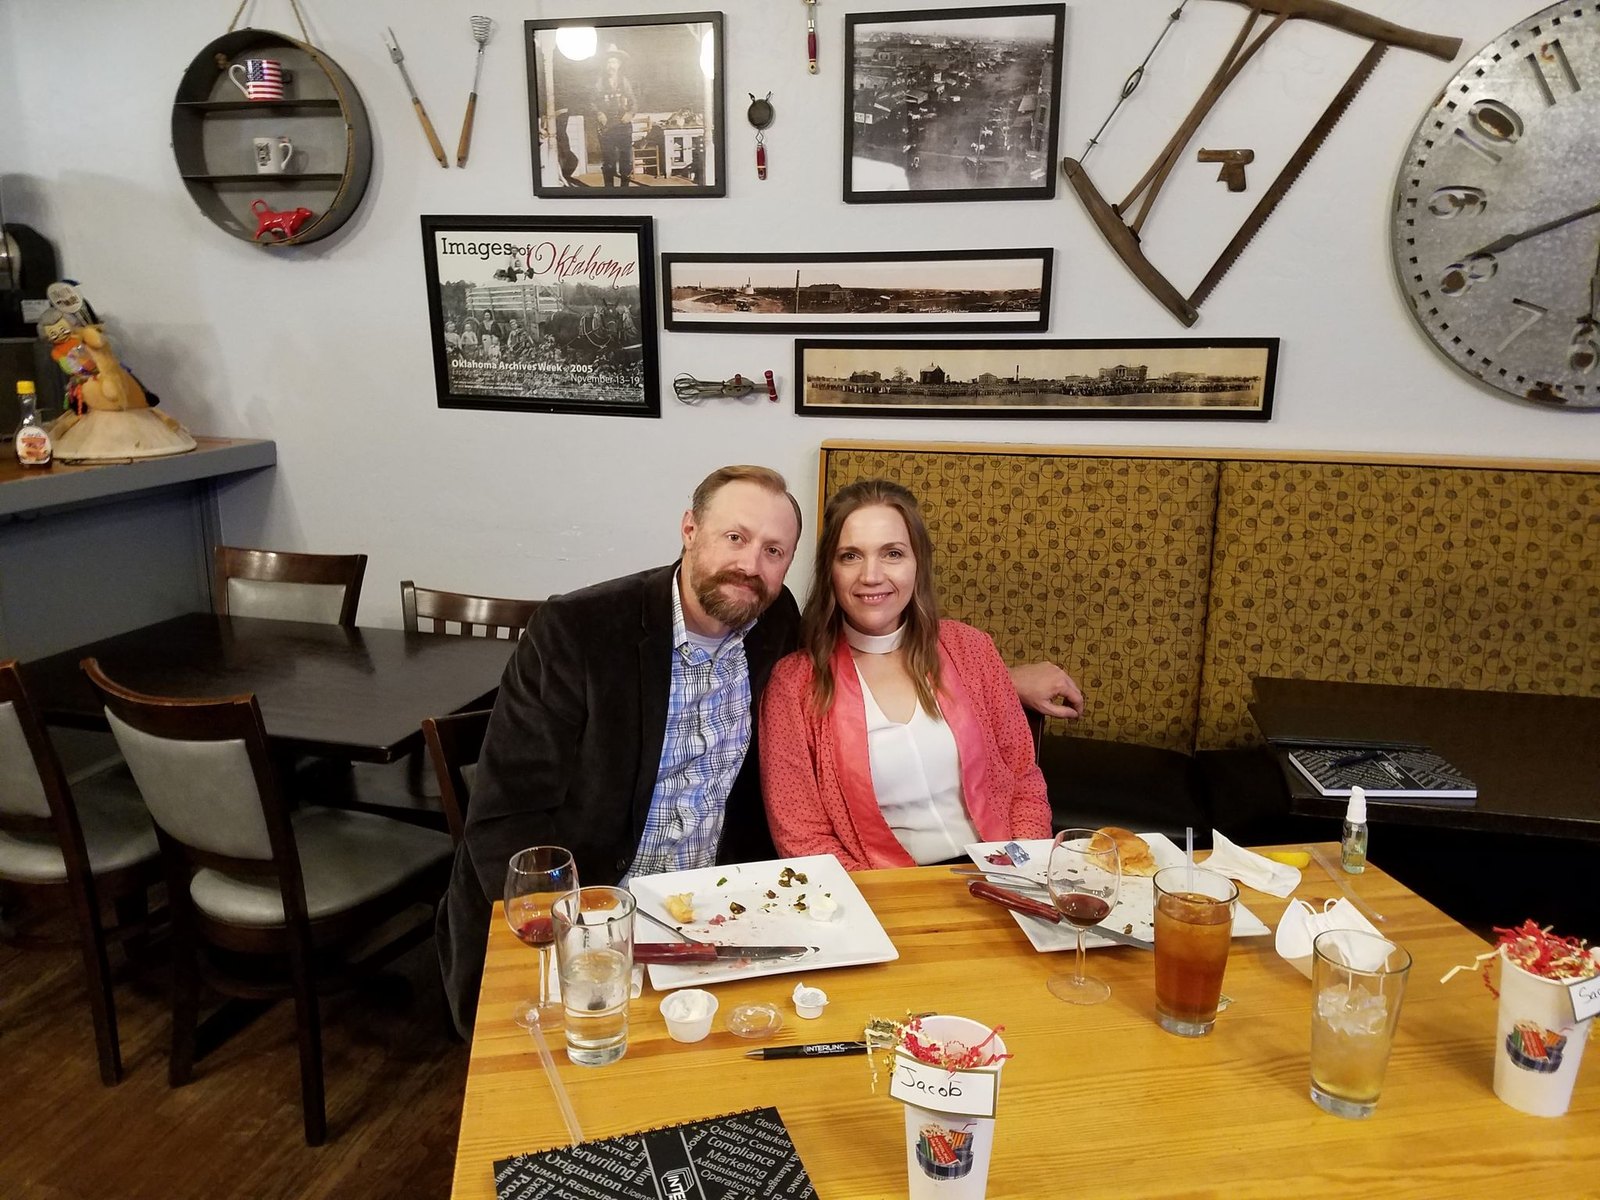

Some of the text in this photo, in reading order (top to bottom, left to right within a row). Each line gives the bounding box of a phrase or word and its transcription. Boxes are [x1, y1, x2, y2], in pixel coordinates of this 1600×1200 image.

[441, 237, 513, 260] Images
[526, 241, 636, 290] Oklahoma
[451, 359, 498, 369] Oklahoma
[499, 361, 537, 372] Archives
[538, 361, 563, 373] Week
[570, 364, 593, 374] 2005
[571, 373, 612, 385] November
[900, 1065, 963, 1097] Jacob
[710, 1125, 788, 1158] Quality Control
[725, 1120, 792, 1148] Capital Markets
[754, 1118, 788, 1135] Closing
[706, 1149, 768, 1180] Marketing
[707, 1136, 776, 1167] Compliance
[524, 1162, 566, 1183] HUMAN
[545, 1154, 622, 1191] Origination
[694, 1157, 762, 1187] Administrative
[700, 1169, 757, 1195] Operations
[763, 1161, 796, 1196] Managers
